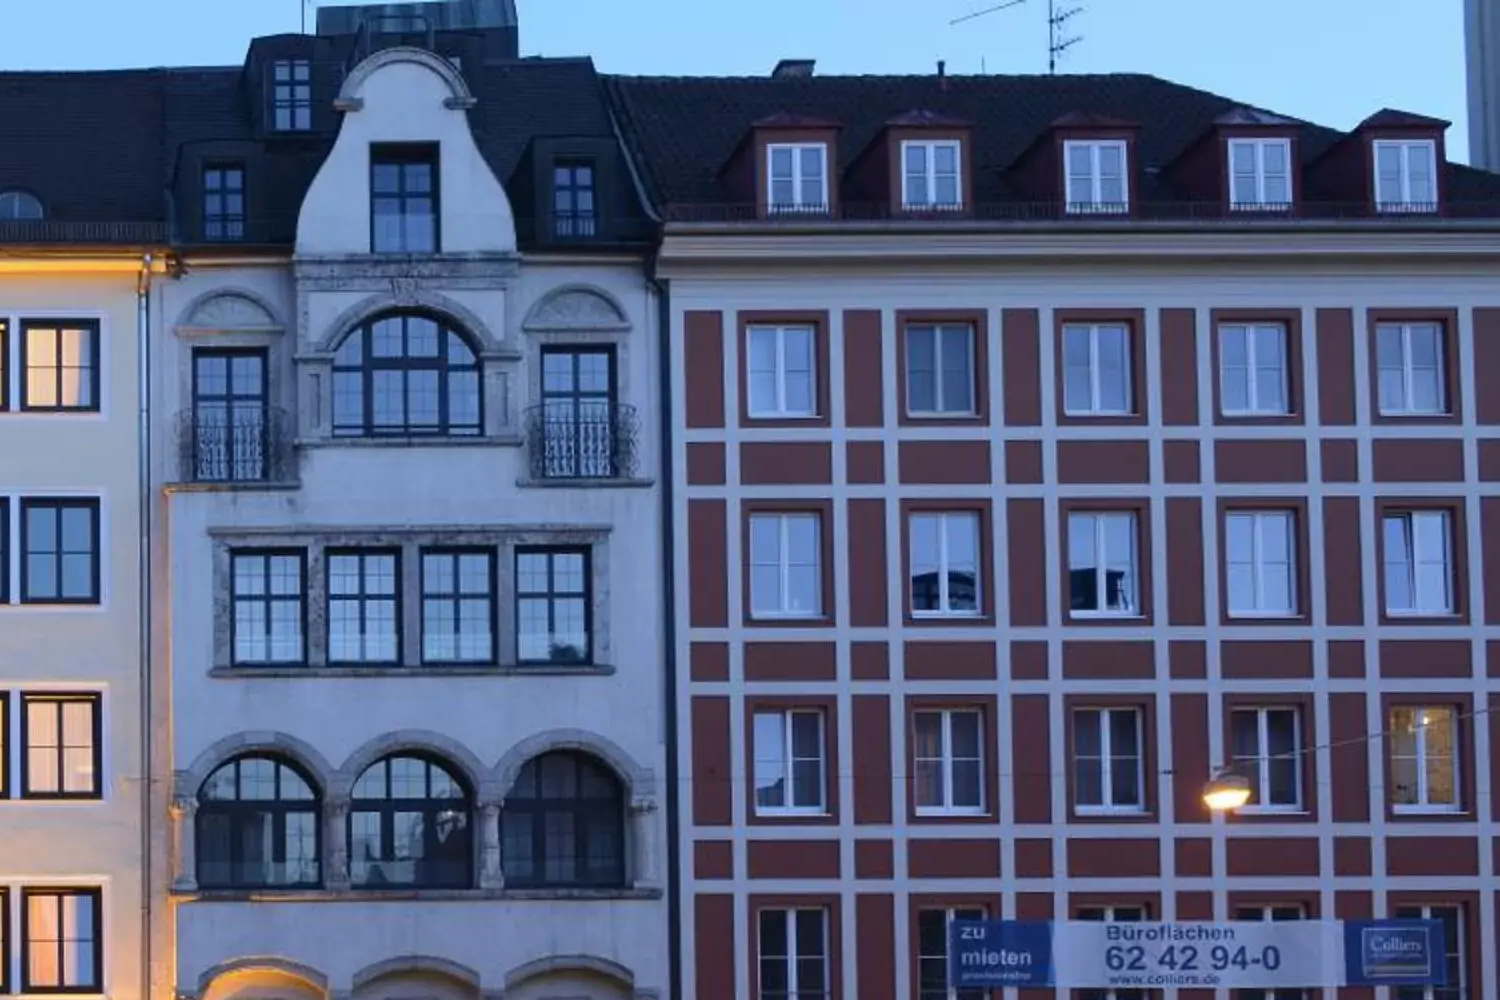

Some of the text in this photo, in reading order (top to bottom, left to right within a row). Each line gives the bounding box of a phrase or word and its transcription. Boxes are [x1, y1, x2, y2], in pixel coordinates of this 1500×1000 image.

[961, 926, 986, 940] zu
[1106, 924, 1235, 941] Büroflächen
[1370, 935, 1422, 952] Colliers
[961, 948, 1032, 966] mieten
[1105, 945, 1281, 971] 62 42 94-0
[1109, 974, 1221, 986] www.colliers.de
